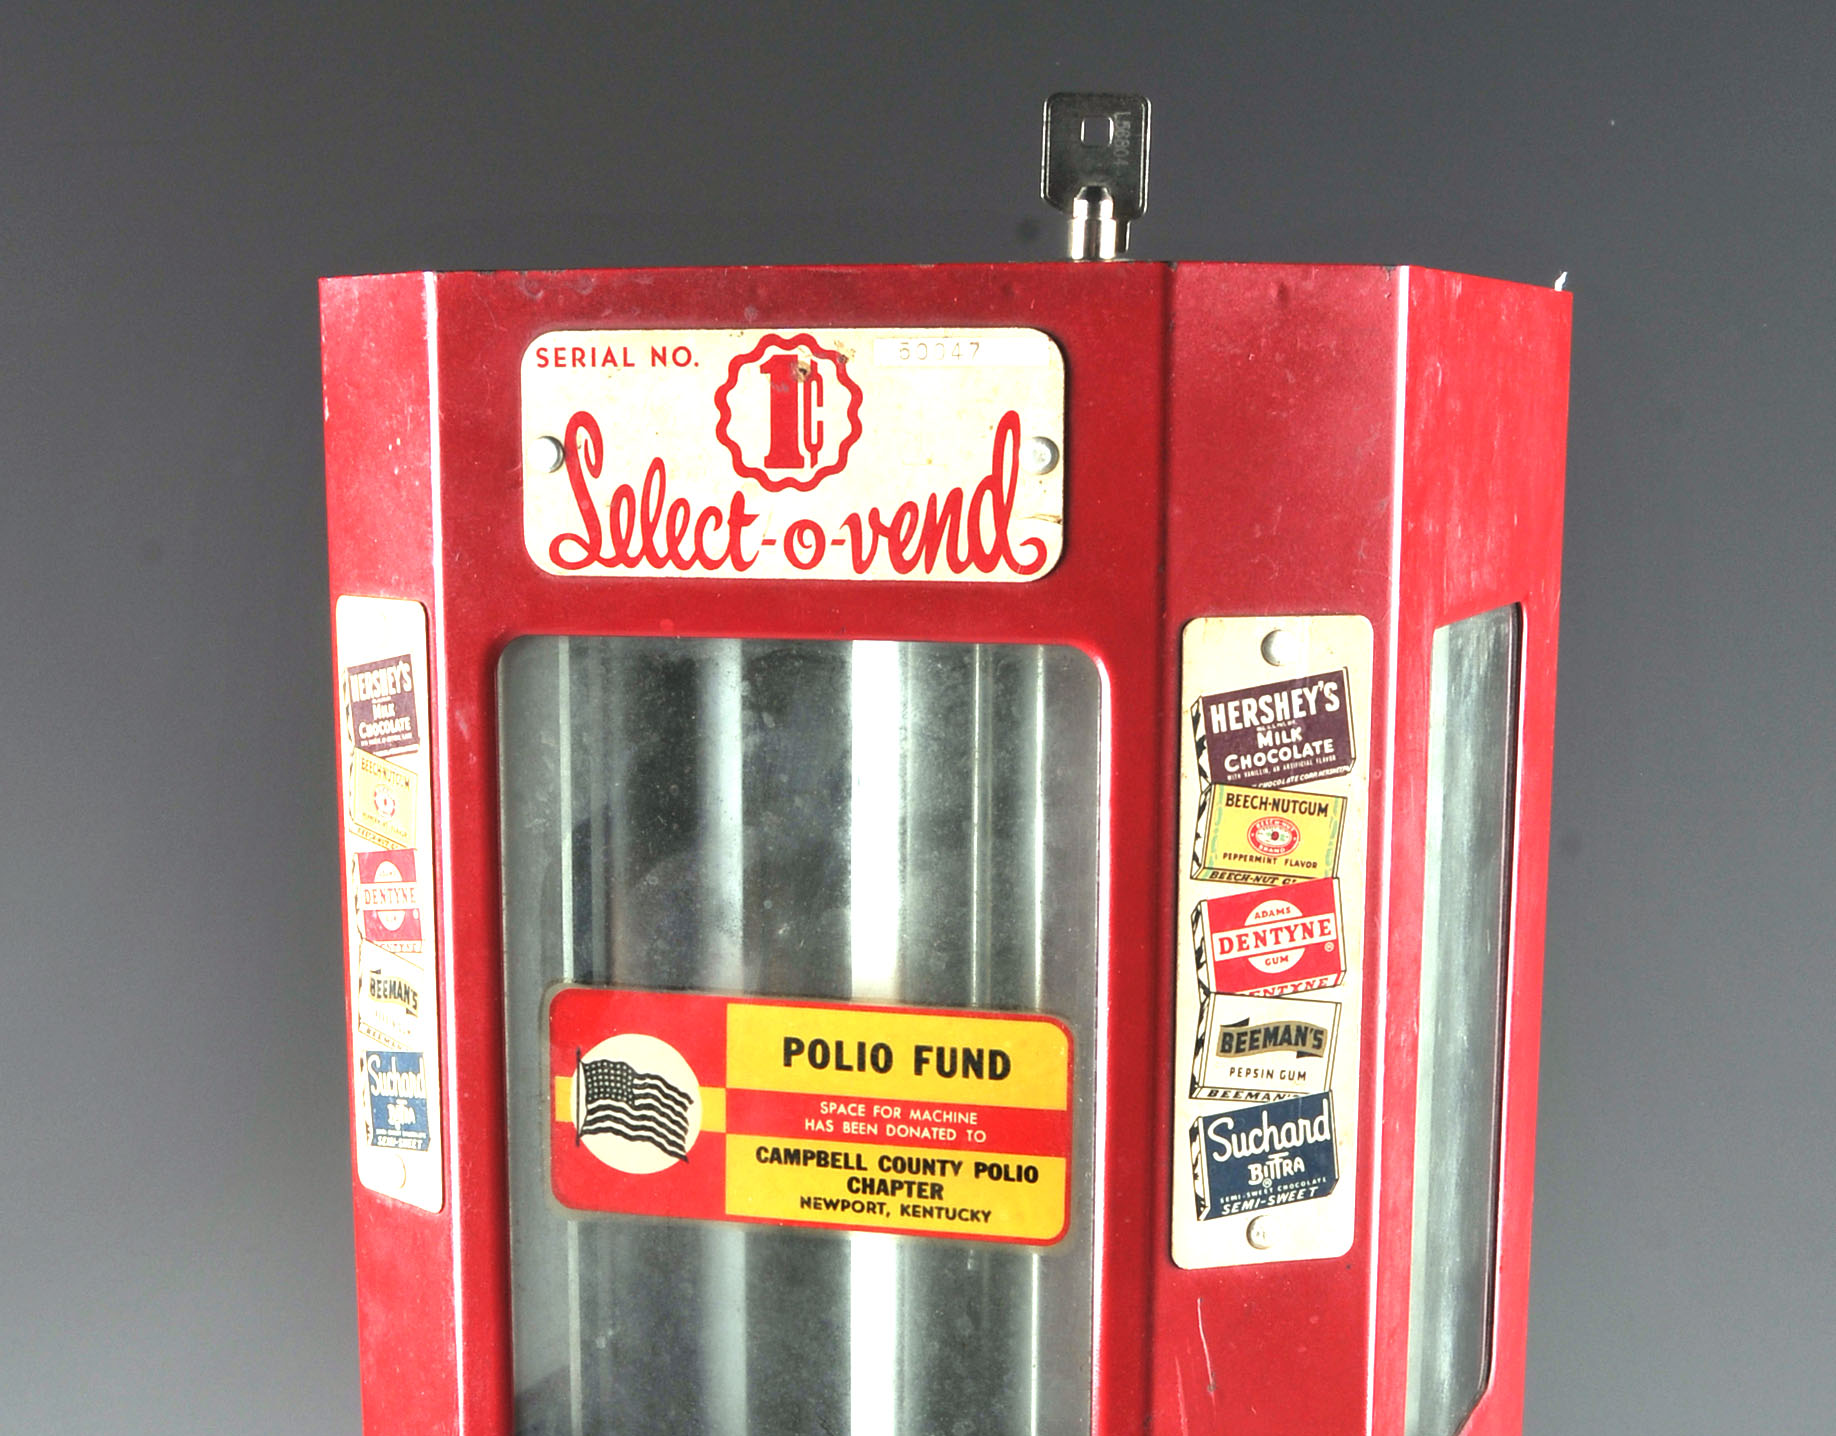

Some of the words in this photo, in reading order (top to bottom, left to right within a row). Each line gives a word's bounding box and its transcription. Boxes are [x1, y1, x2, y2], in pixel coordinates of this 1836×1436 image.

[536, 346, 636, 369] SERIAL
[650, 345, 701, 368] NO.
[549, 410, 1048, 575] Select-o-vend
[350, 660, 413, 703] HERSHEY'S
[1209, 681, 1341, 735] HERSHEY'S
[1256, 726, 1303, 749] MILK
[1224, 738, 1335, 773] CHOCOLATE
[1222, 852, 1278, 865] PEPPERMINT
[1284, 858, 1318, 869] FLAVOR
[1208, 870, 1279, 885] BEECH-NUT
[364, 887, 417, 905] DENTYNE
[1254, 906, 1291, 920] ADAMS
[1218, 918, 1332, 955] DENTYNE
[1264, 954, 1289, 966] GUM
[369, 977, 419, 1010] BEEMAN'S
[1248, 977, 1329, 998] ENTYNE
[1219, 1024, 1325, 1054] BEEMAN'S
[782, 1036, 894, 1074] POLIO
[913, 1044, 1012, 1081] FUND
[367, 1054, 427, 1099] Suchard
[1229, 1066, 1275, 1080] PEPSIN
[1279, 1069, 1307, 1081] GUM
[819, 1101, 866, 1118] SPACE
[873, 1105, 902, 1119] FOR
[909, 1108, 979, 1126] MACHINE
[804, 1118, 835, 1133] HAS
[842, 1121, 878, 1136] BEEN
[886, 1124, 957, 1142] DONATED
[966, 1128, 987, 1144] TO
[1207, 1098, 1332, 1162] Suchard
[755, 1145, 868, 1171] CAMPBELL
[877, 1154, 964, 1177] COUNTY
[973, 1161, 1040, 1184] POLIO
[846, 1176, 945, 1201] CHAPTER
[1277, 1176, 1327, 1192] CHOCOLATE
[799, 1196, 891, 1218] NEWPORT,
[900, 1203, 993, 1224] KENTUCKY
[1221, 1186, 1319, 1216] SEMI-SWEET
